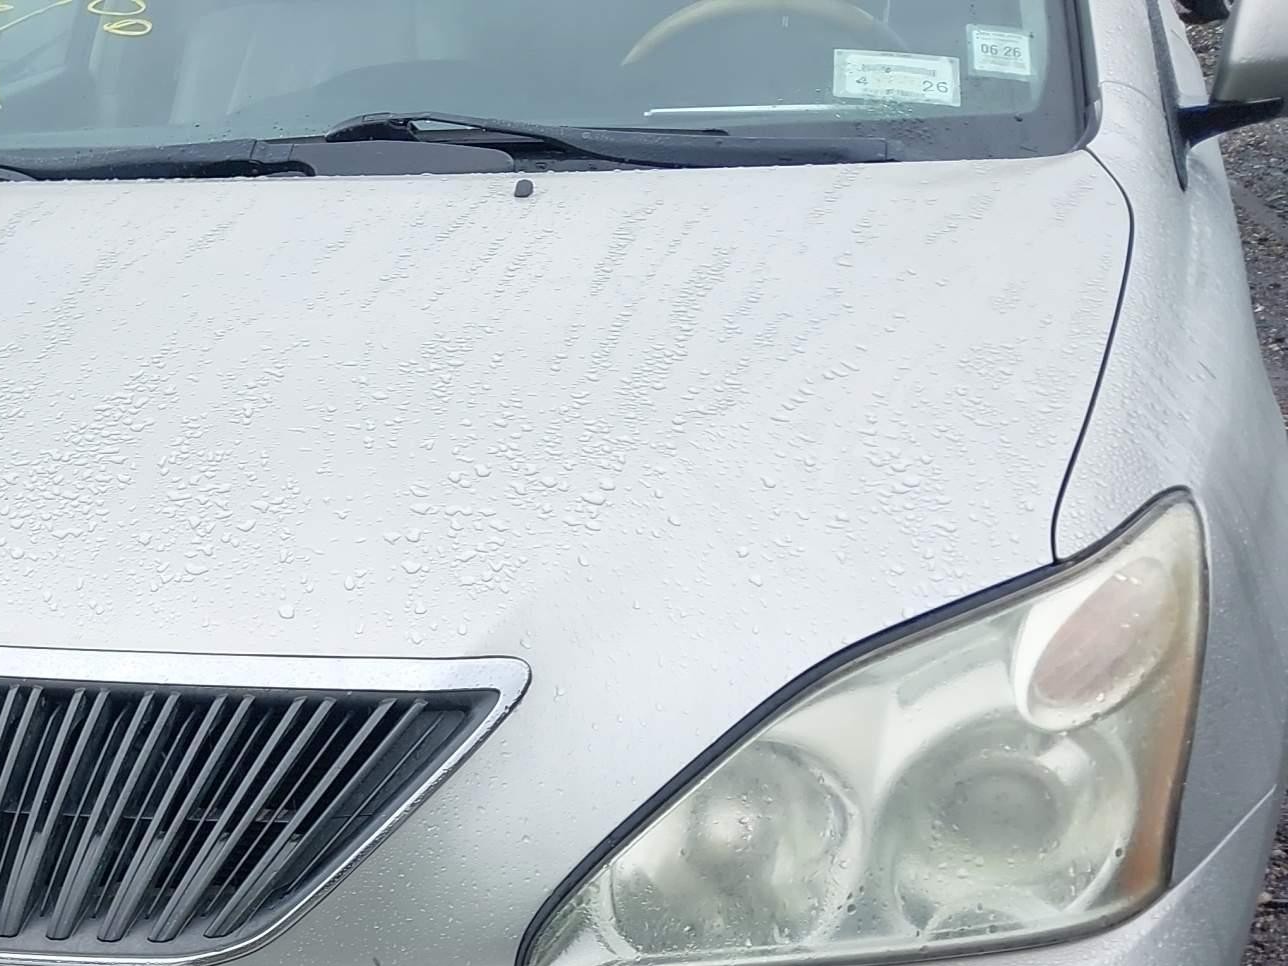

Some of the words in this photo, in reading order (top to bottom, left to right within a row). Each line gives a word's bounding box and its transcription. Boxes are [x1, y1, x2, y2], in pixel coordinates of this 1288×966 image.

[980, 43, 998, 56] 06
[1003, 45, 1022, 58] 26
[922, 80, 949, 94] 26
